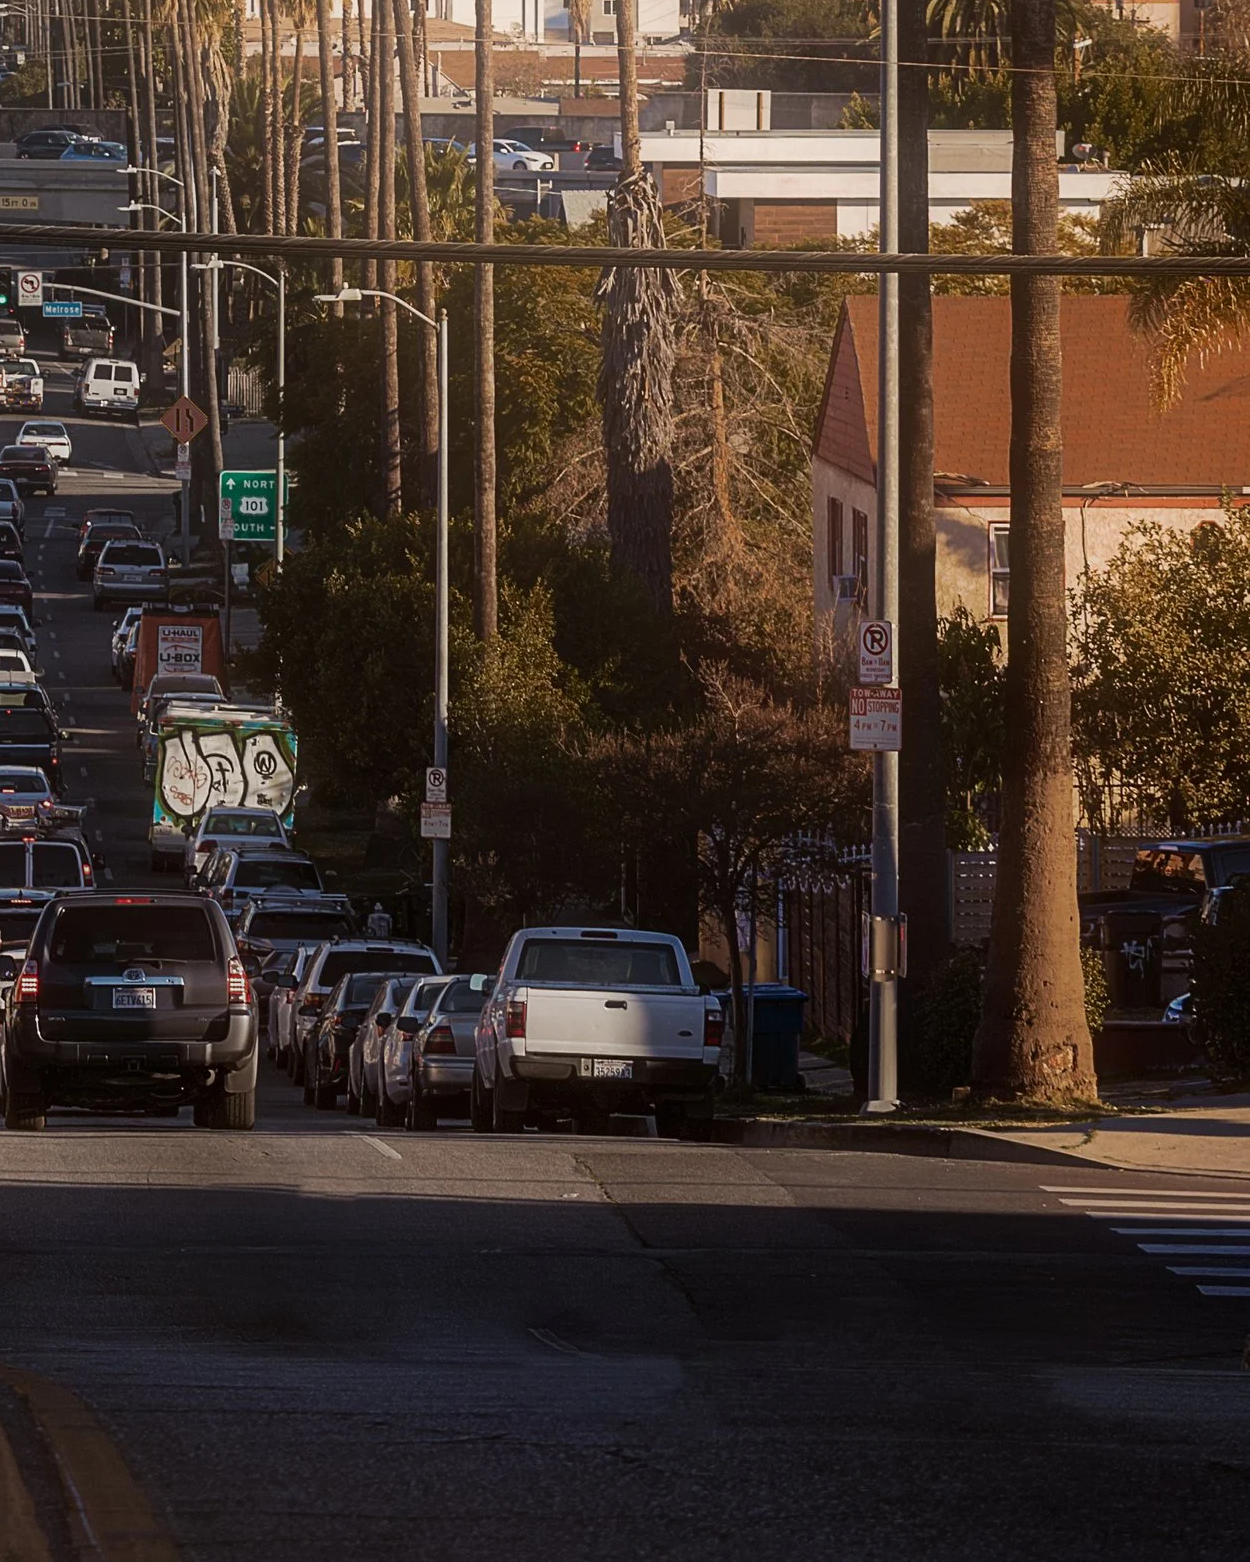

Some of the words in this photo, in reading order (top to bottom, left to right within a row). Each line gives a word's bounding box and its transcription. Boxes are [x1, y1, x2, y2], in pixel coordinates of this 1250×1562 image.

[2, 198, 10, 207] 15
[45, 305, 80, 314] Melrose
[243, 479, 275, 489] NORT
[245, 501, 264, 511] 101
[233, 523, 265, 532] OUTH
[159, 652, 200, 663] U-BOX
[852, 688, 899, 698] TOW-AWAY
[851, 698, 865, 715] NO
[867, 700, 900, 714] STOPPING
